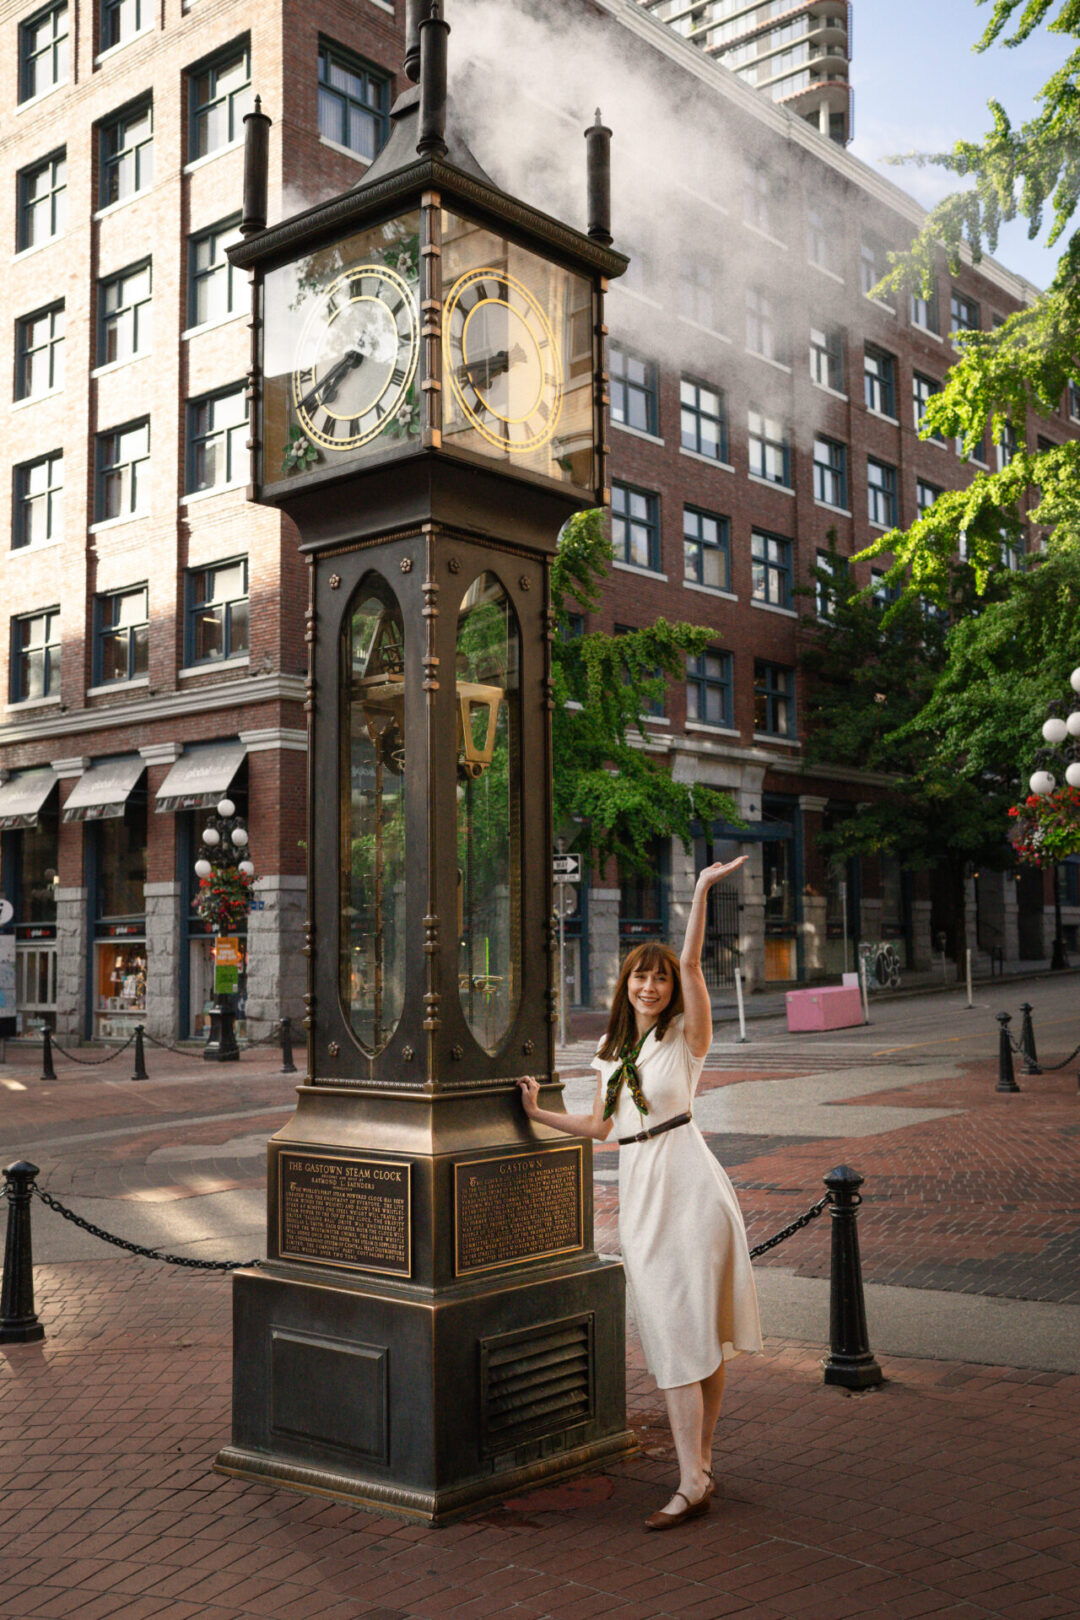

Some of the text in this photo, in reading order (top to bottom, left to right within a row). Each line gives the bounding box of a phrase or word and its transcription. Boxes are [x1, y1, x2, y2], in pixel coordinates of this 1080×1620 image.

[289, 1161, 302, 1171] THE
[305, 1163, 343, 1175] GASTOWN
[345, 1167, 371, 1178] STEAM
[374, 1170, 401, 1182] CLOCK
[499, 1160, 542, 1174] GASTOWN
